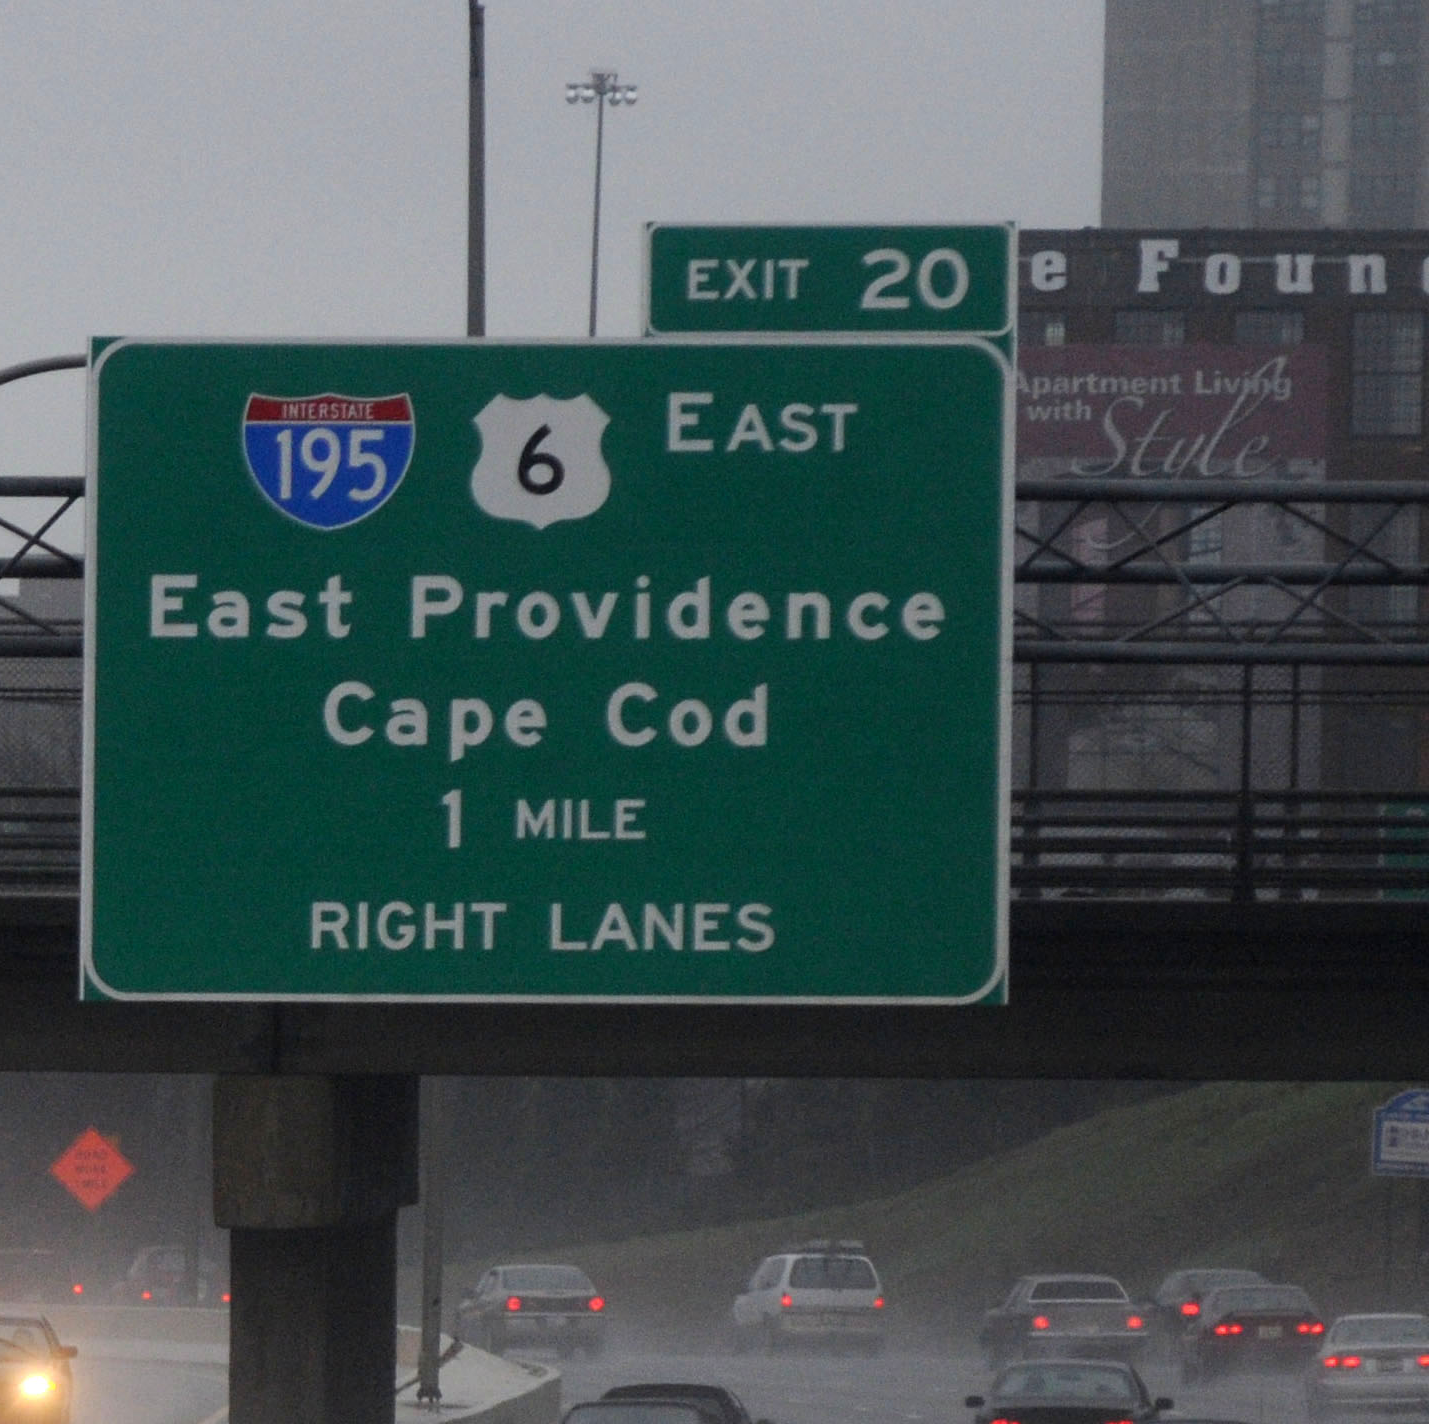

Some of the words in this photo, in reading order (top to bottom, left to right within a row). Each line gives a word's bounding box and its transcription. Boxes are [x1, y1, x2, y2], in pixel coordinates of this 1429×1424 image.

[687, 258, 809, 300] EXIT
[860, 248, 969, 310] 20
[1137, 239, 1429, 295] Foun
[282, 403, 375, 421] INTERSTATE
[1014, 370, 1181, 398] Apartment
[1196, 370, 1290, 400] Living
[1027, 399, 1092, 421] with
[275, 427, 388, 502] 195
[517, 424, 565, 496] 6
[667, 392, 858, 453] EAST
[150, 574, 352, 639] East
[410, 575, 945, 641] Providence
[323, 681, 547, 762] Cape
[606, 682, 769, 747] Cod
[441, 789, 461, 849] 1
[516, 799, 646, 840] MILE
[310, 901, 507, 951] RIGHT
[550, 902, 776, 952] LANES
